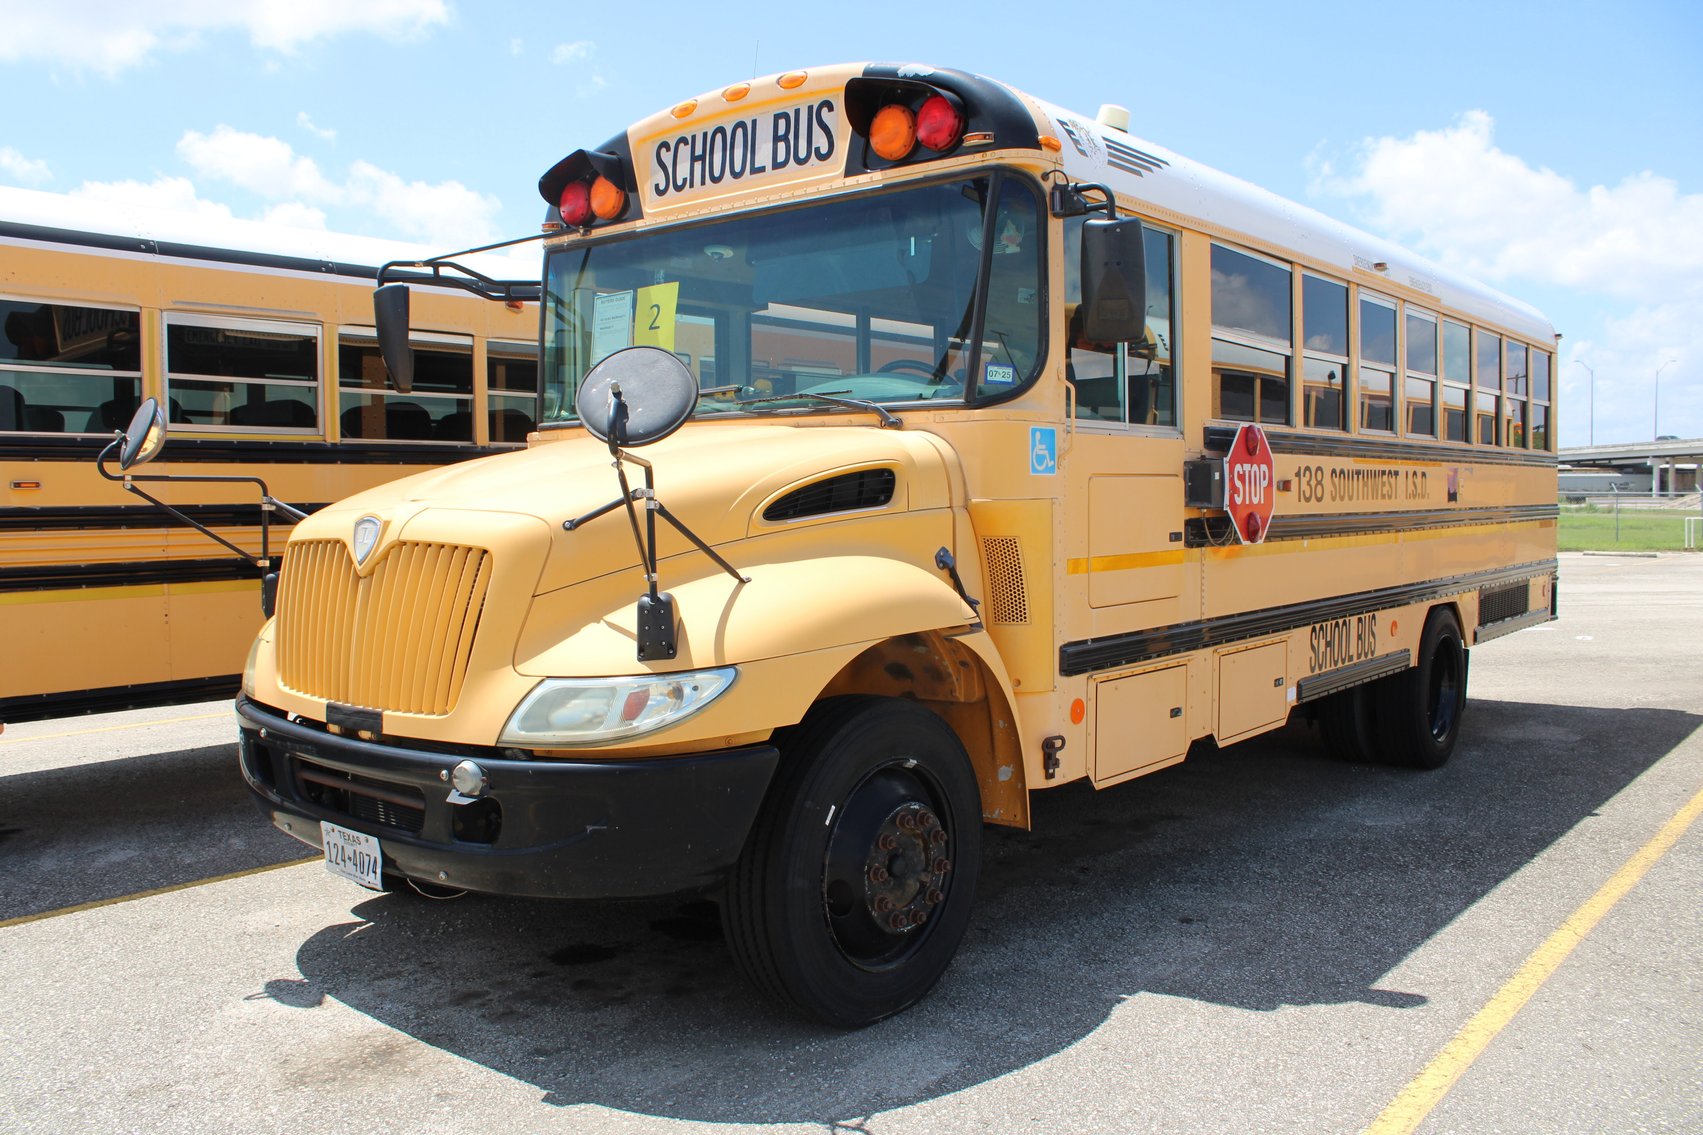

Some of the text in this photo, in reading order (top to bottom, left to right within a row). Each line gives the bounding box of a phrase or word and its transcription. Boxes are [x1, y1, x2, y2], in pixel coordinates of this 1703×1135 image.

[655, 99, 835, 197] SCHOOL BUS
[648, 303, 661, 331] 2
[1234, 463, 1268, 505] STOP
[1295, 465, 1430, 503] 138 SOUTHWEST I.S.D.
[1309, 612, 1377, 674] SCHOOL BUS
[338, 829, 362, 846] TEXAS
